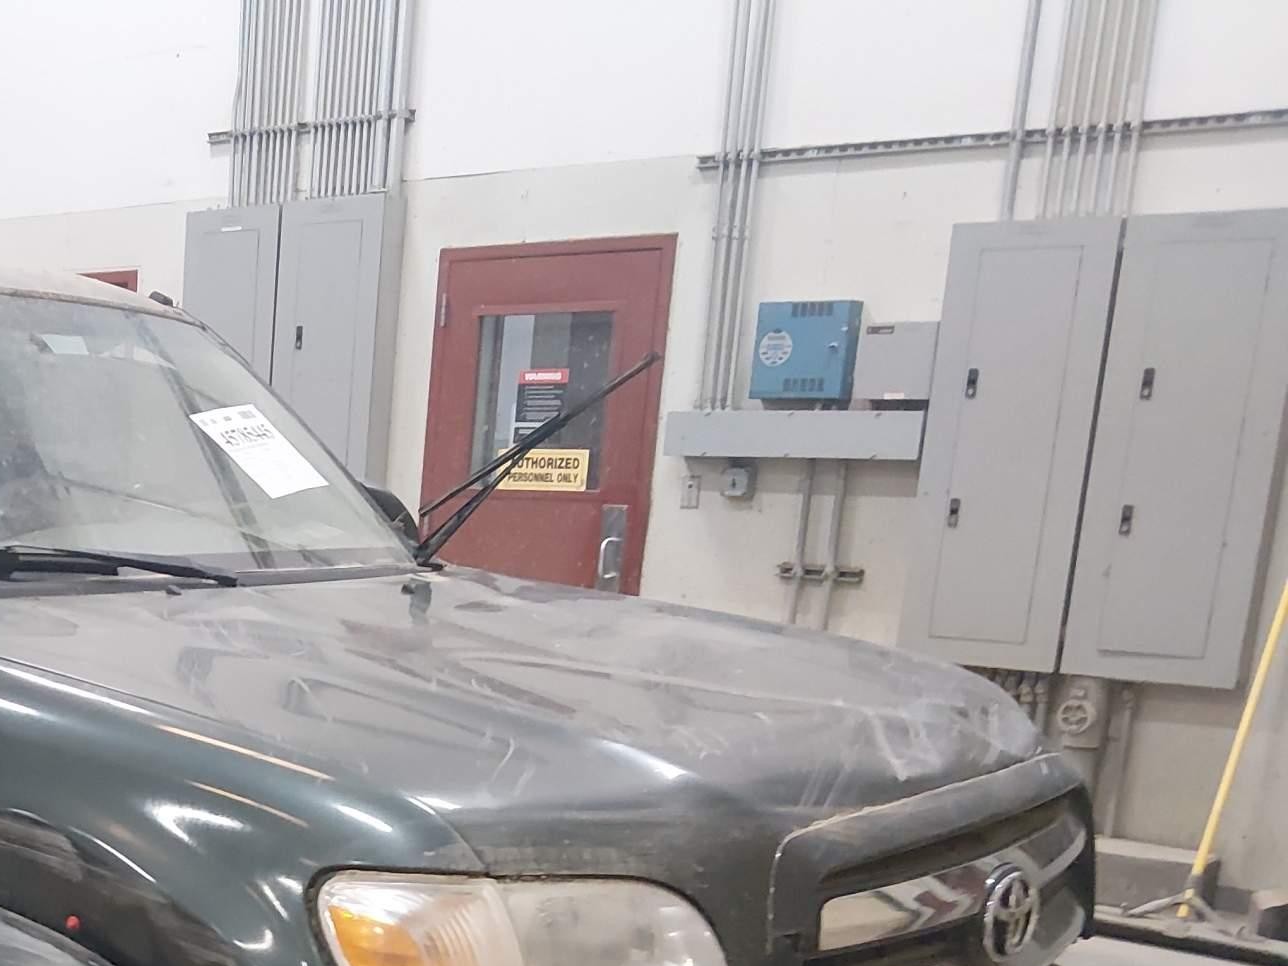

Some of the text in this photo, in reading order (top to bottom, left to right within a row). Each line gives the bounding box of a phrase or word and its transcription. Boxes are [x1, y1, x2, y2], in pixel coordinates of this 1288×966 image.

[514, 457, 581, 470] UTHORIZED
[507, 471, 579, 483] PERSONNEL ONLY
